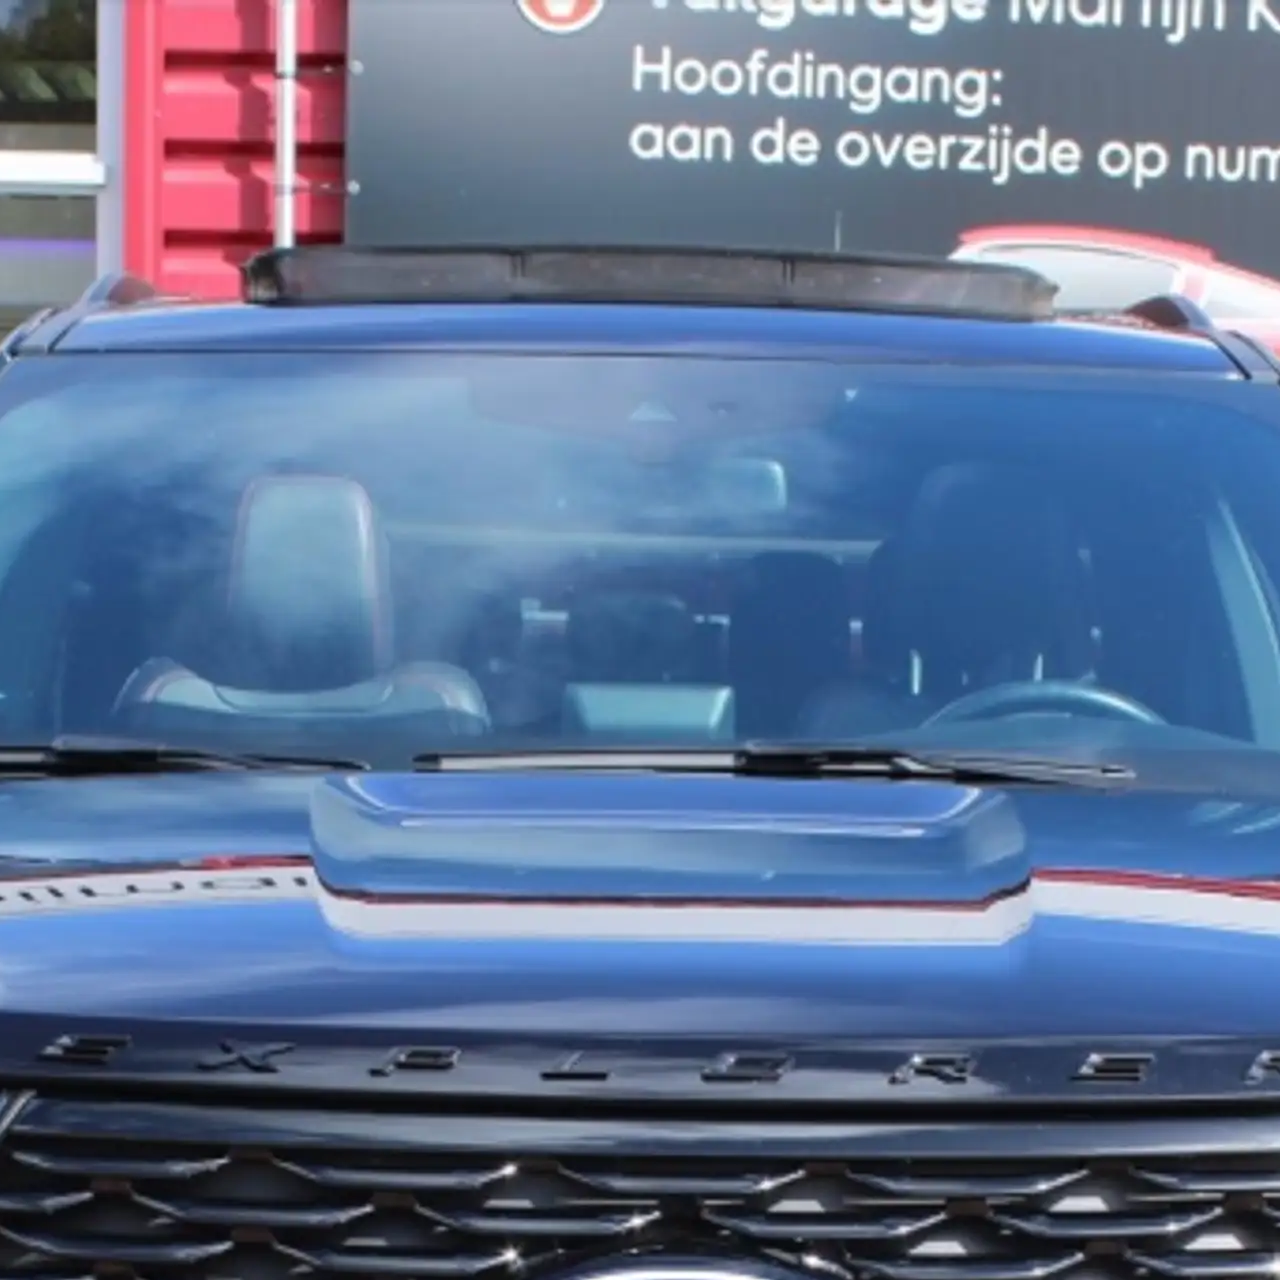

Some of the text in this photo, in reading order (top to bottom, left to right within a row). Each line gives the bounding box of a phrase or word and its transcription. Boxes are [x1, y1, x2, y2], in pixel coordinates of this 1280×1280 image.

[631, 44, 1004, 118] Hoofdingang:
[629, 121, 734, 163] aan
[749, 117, 822, 165] de
[835, 125, 1083, 186] overzijde
[1097, 140, 1169, 190] op
